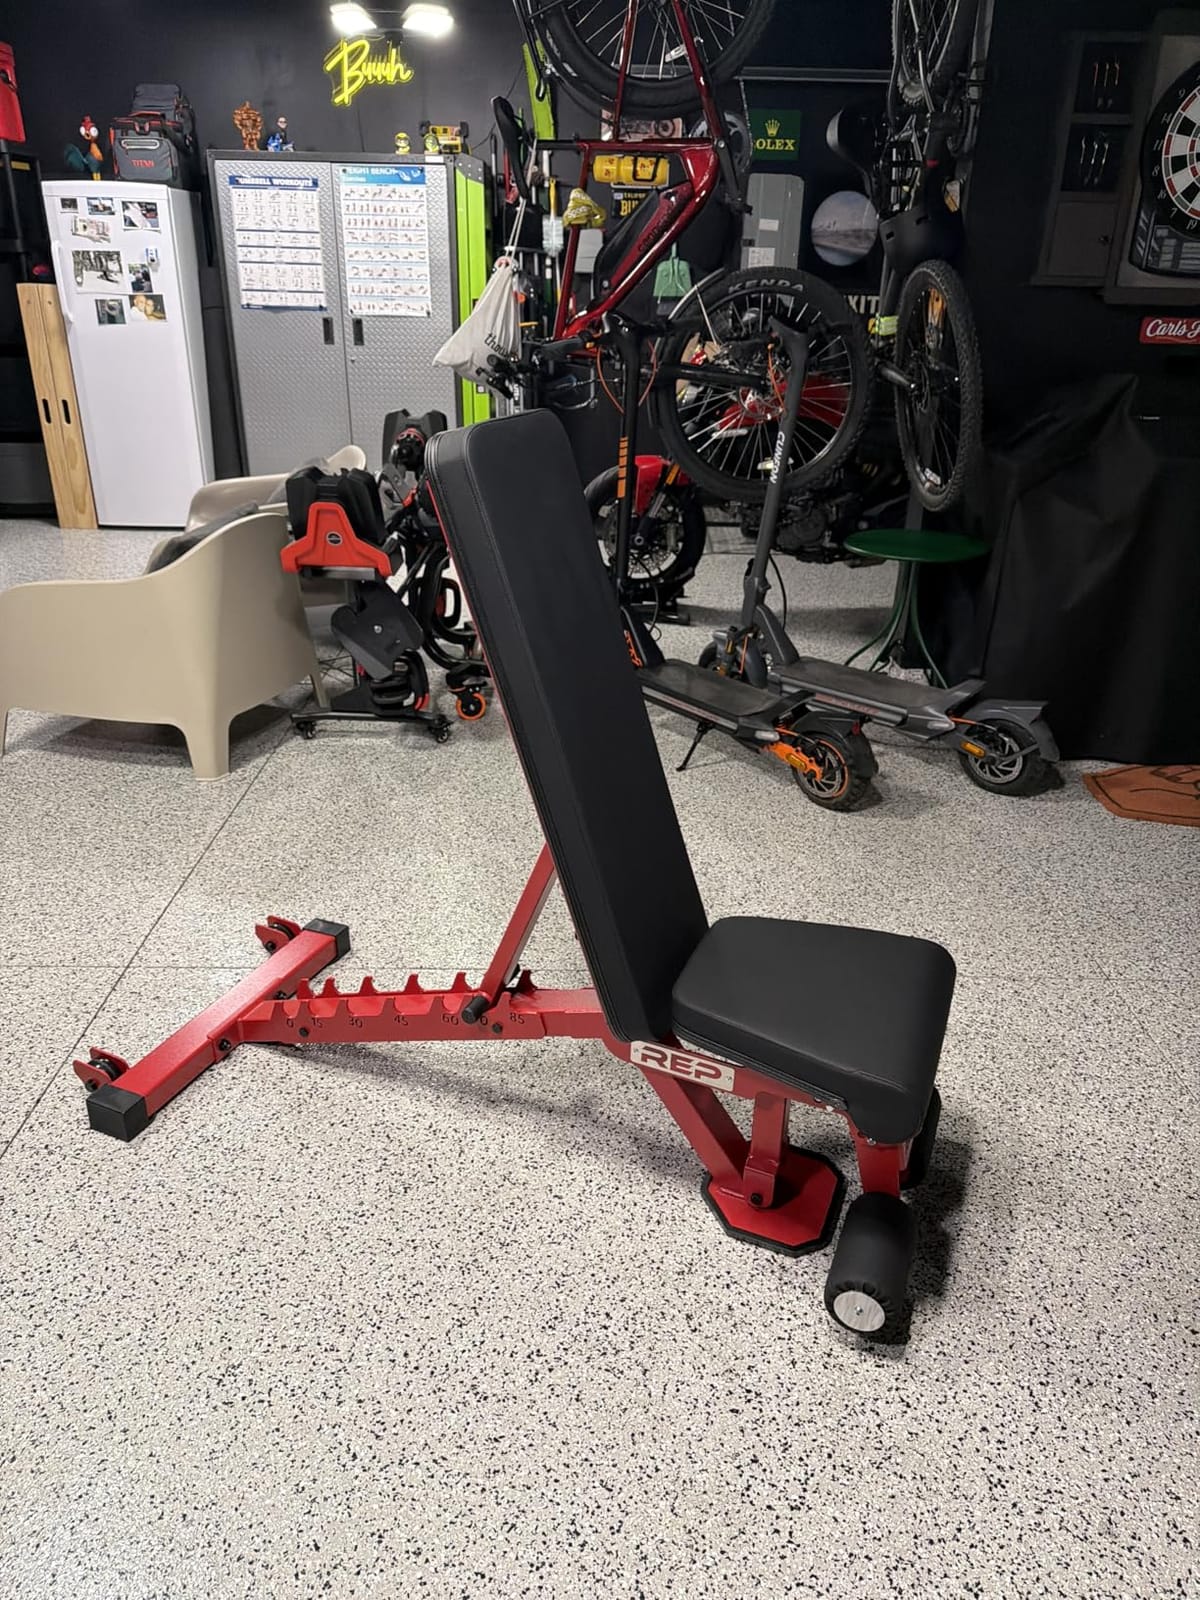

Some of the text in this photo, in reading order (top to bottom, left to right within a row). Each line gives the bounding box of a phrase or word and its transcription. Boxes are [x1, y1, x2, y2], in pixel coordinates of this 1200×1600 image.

[754, 138, 796, 151] OLEX
[728, 278, 804, 295] KENDA
[845, 295, 880, 314] XIT
[1146, 319, 1186, 337] Carl's
[509, 1012, 526, 1025] 85
[640, 1045, 723, 1080] REP
